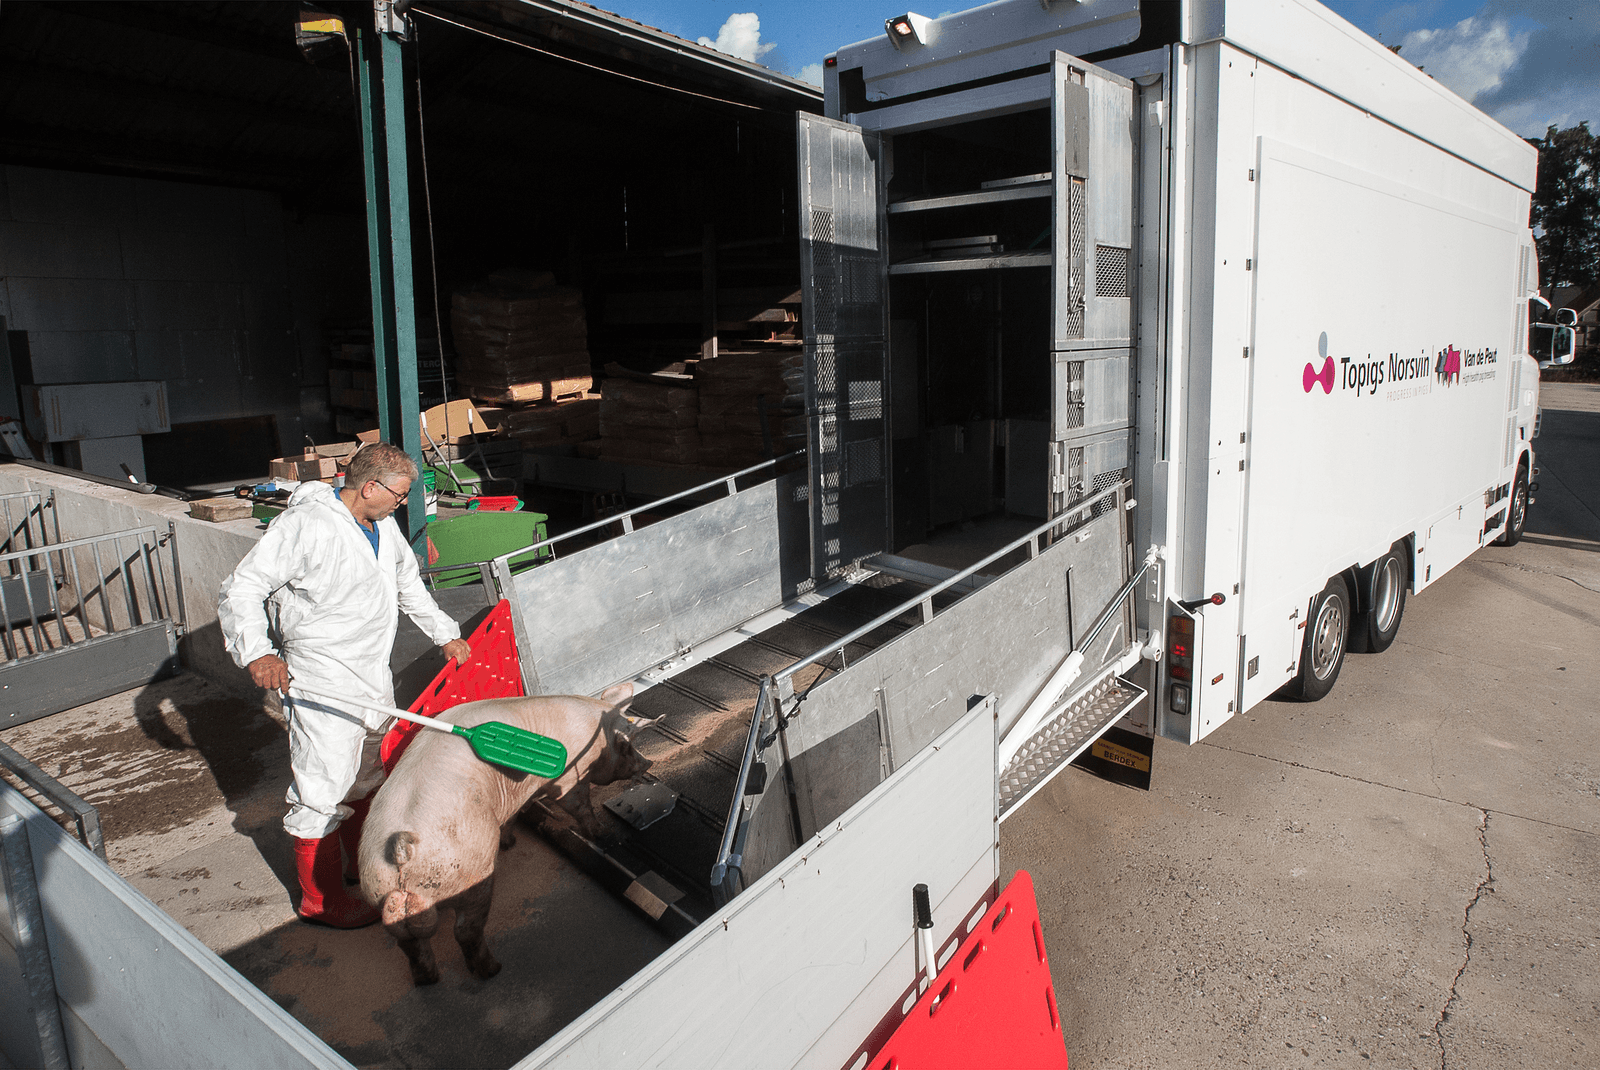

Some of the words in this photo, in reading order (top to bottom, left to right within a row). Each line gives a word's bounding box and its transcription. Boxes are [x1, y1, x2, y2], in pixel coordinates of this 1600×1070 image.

[1464, 349, 1475, 368] Van
[1476, 348, 1484, 366] de
[1485, 347, 1497, 365] Peut
[1341, 354, 1384, 397] Topigs
[1388, 349, 1429, 382] Norsvin
[1104, 750, 1135, 767] BERDEX
